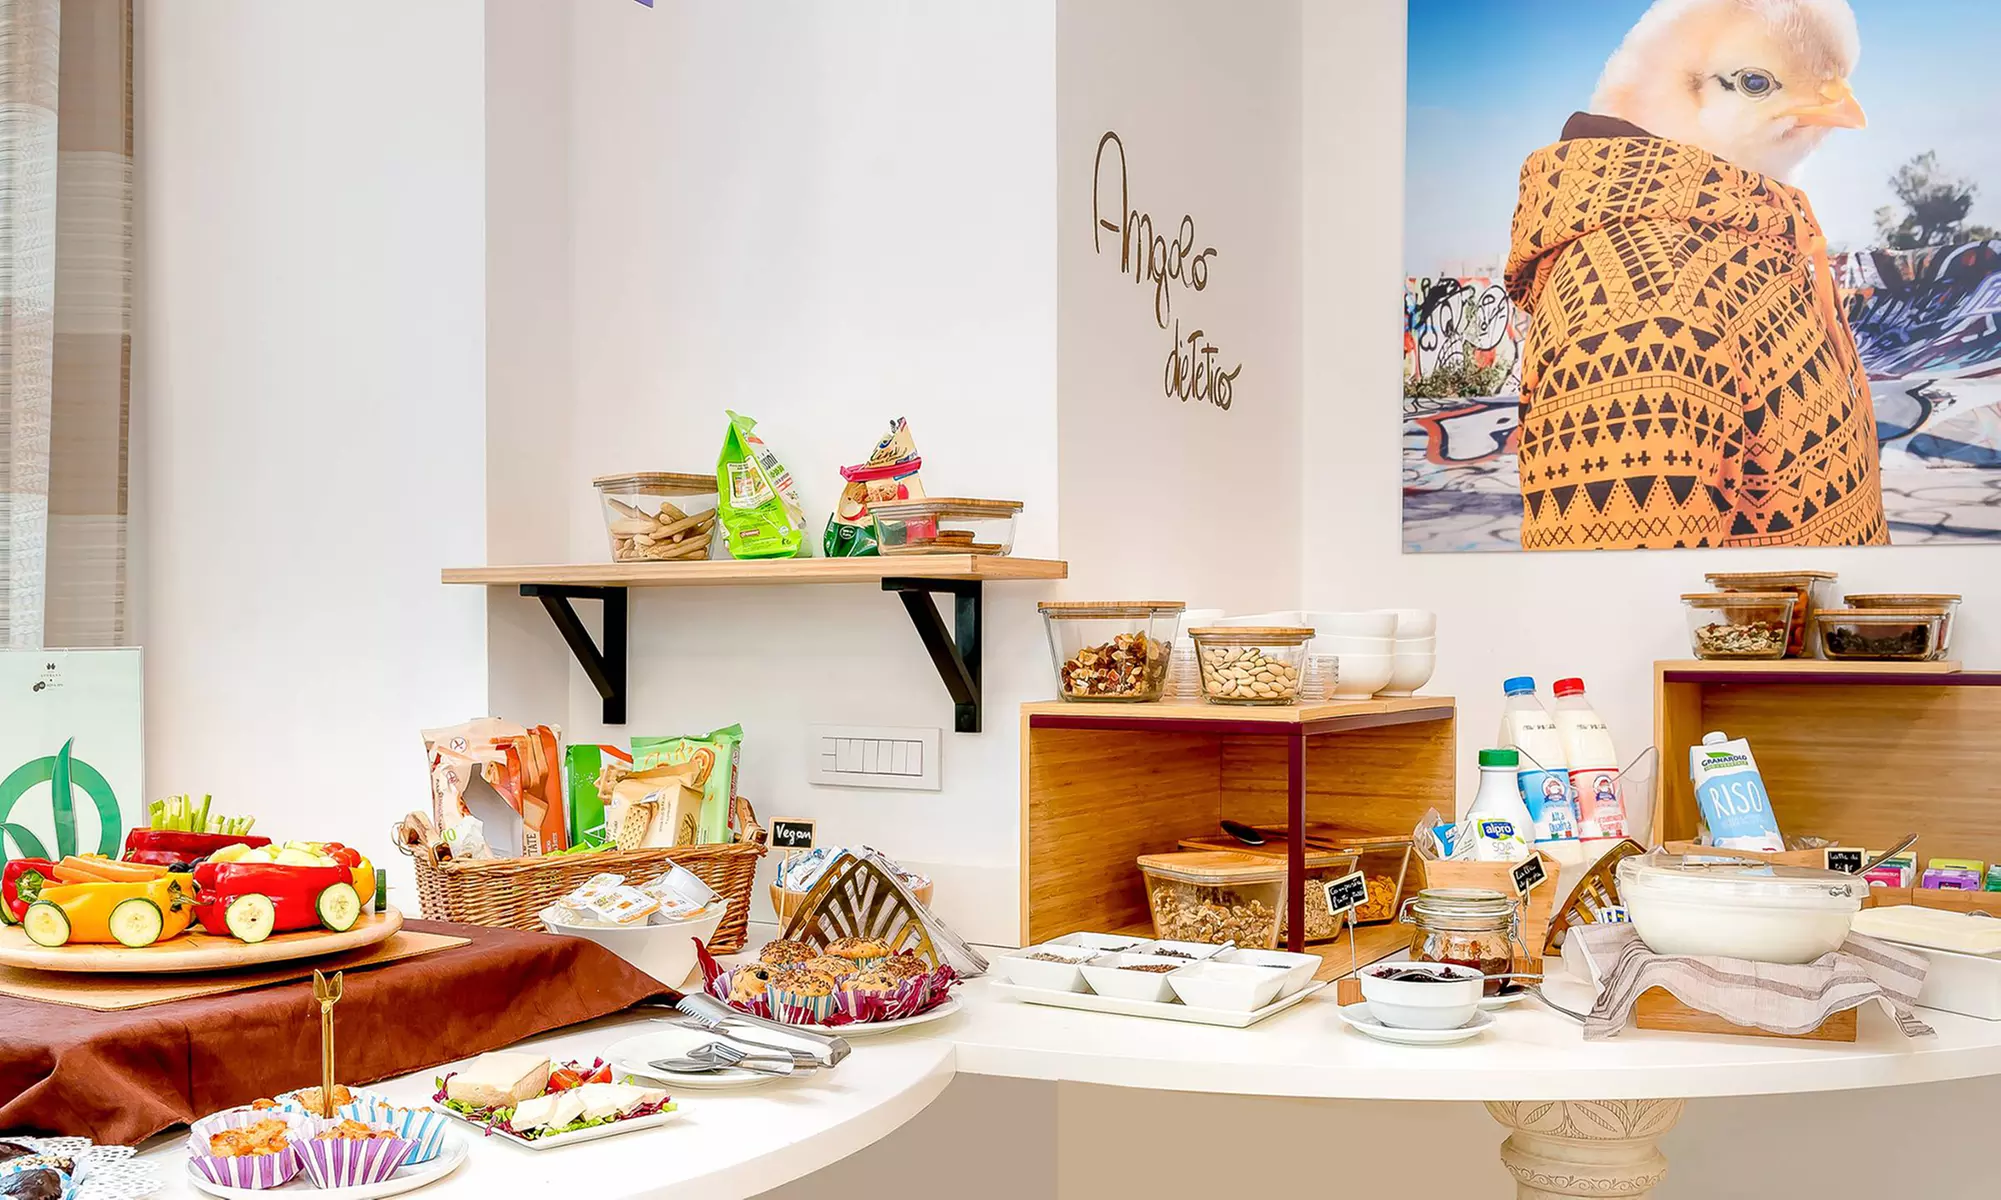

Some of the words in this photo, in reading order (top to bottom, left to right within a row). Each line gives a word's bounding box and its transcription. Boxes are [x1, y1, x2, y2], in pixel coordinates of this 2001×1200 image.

[1093, 131, 1218, 329] Angolo
[1701, 755, 1747, 767] GRANAROLO
[1709, 780, 1763, 819] RISO
[776, 823, 812, 845] Vegan
[1485, 823, 1511, 837] alpro
